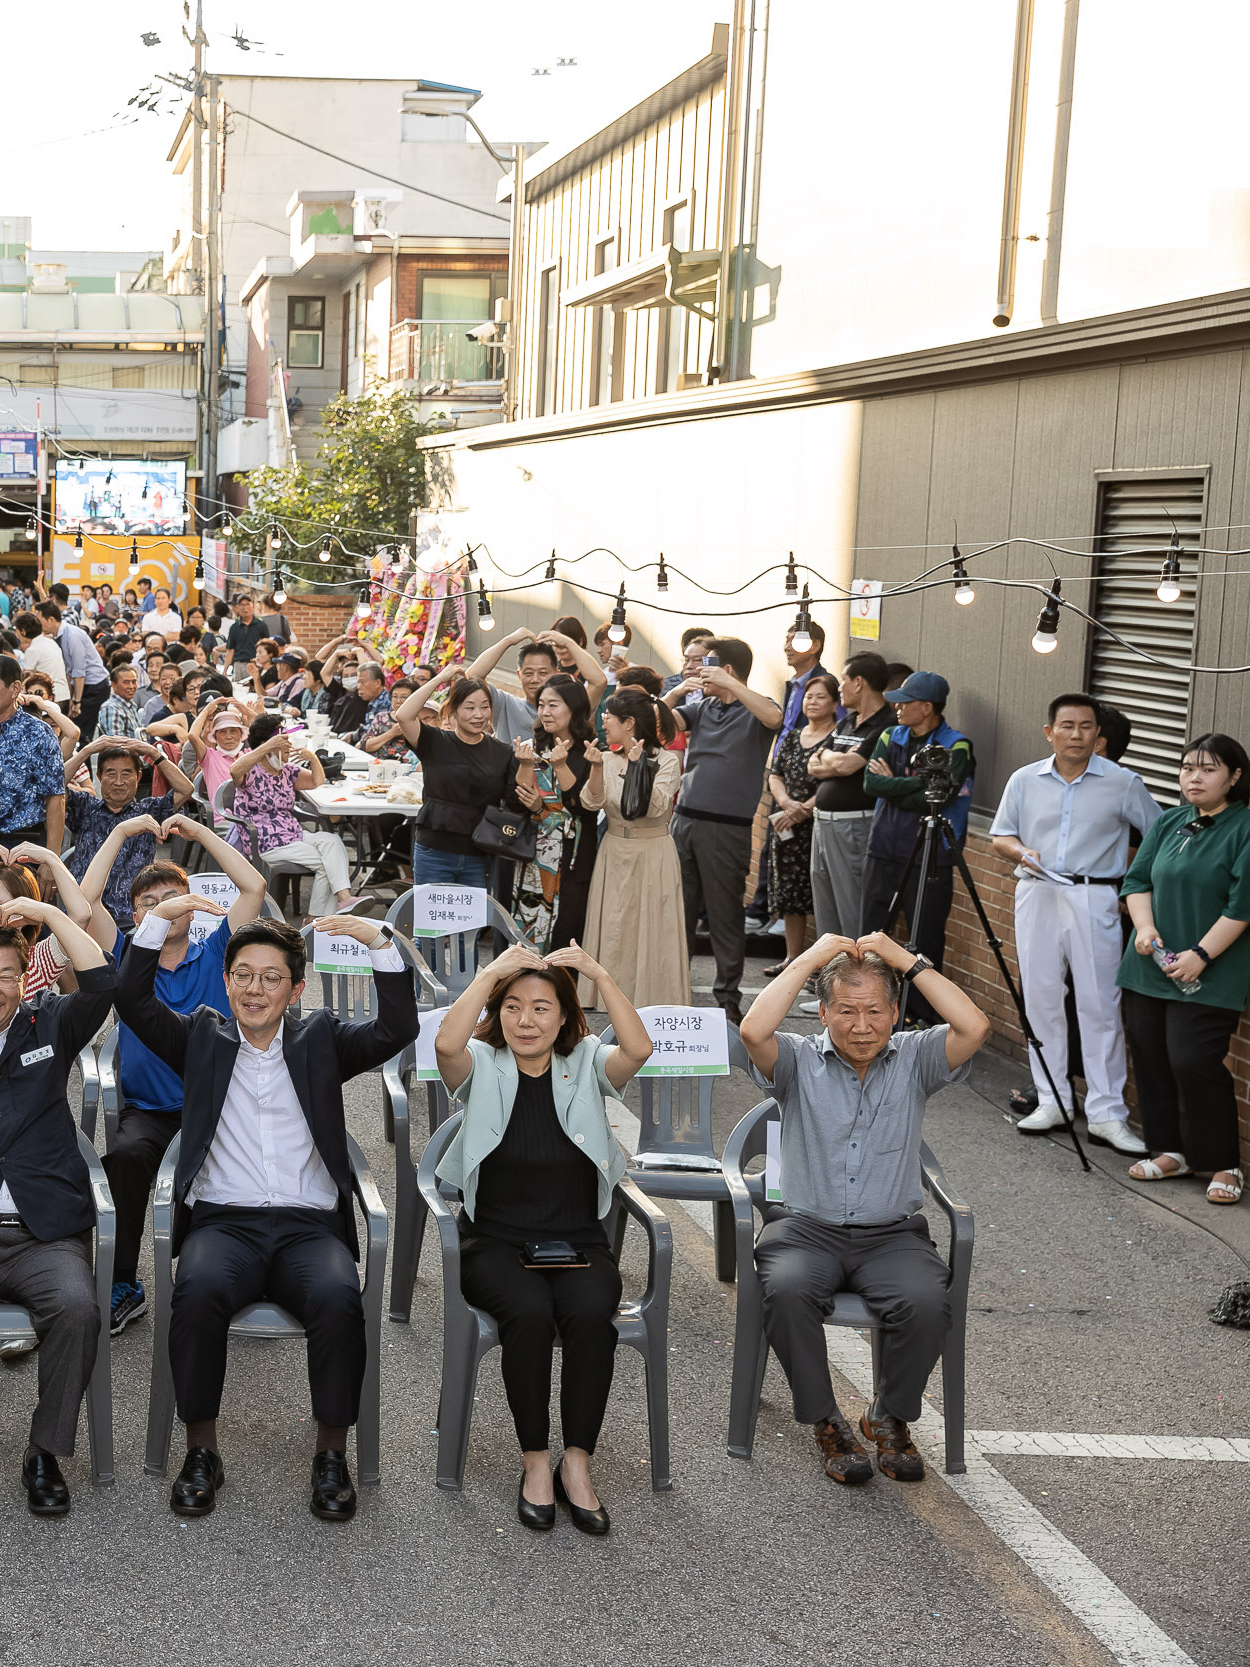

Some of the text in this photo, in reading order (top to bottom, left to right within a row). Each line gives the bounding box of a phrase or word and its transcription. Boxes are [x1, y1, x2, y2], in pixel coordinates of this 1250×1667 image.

[201, 883, 238, 895] 영동교시
[427, 893, 473, 906] 새마을시장
[428, 910, 457, 922] 임재복
[330, 943, 359, 957] 최규철
[654, 1015, 703, 1031] 자양시장
[652, 1039, 710, 1054] 박호규 회장님
